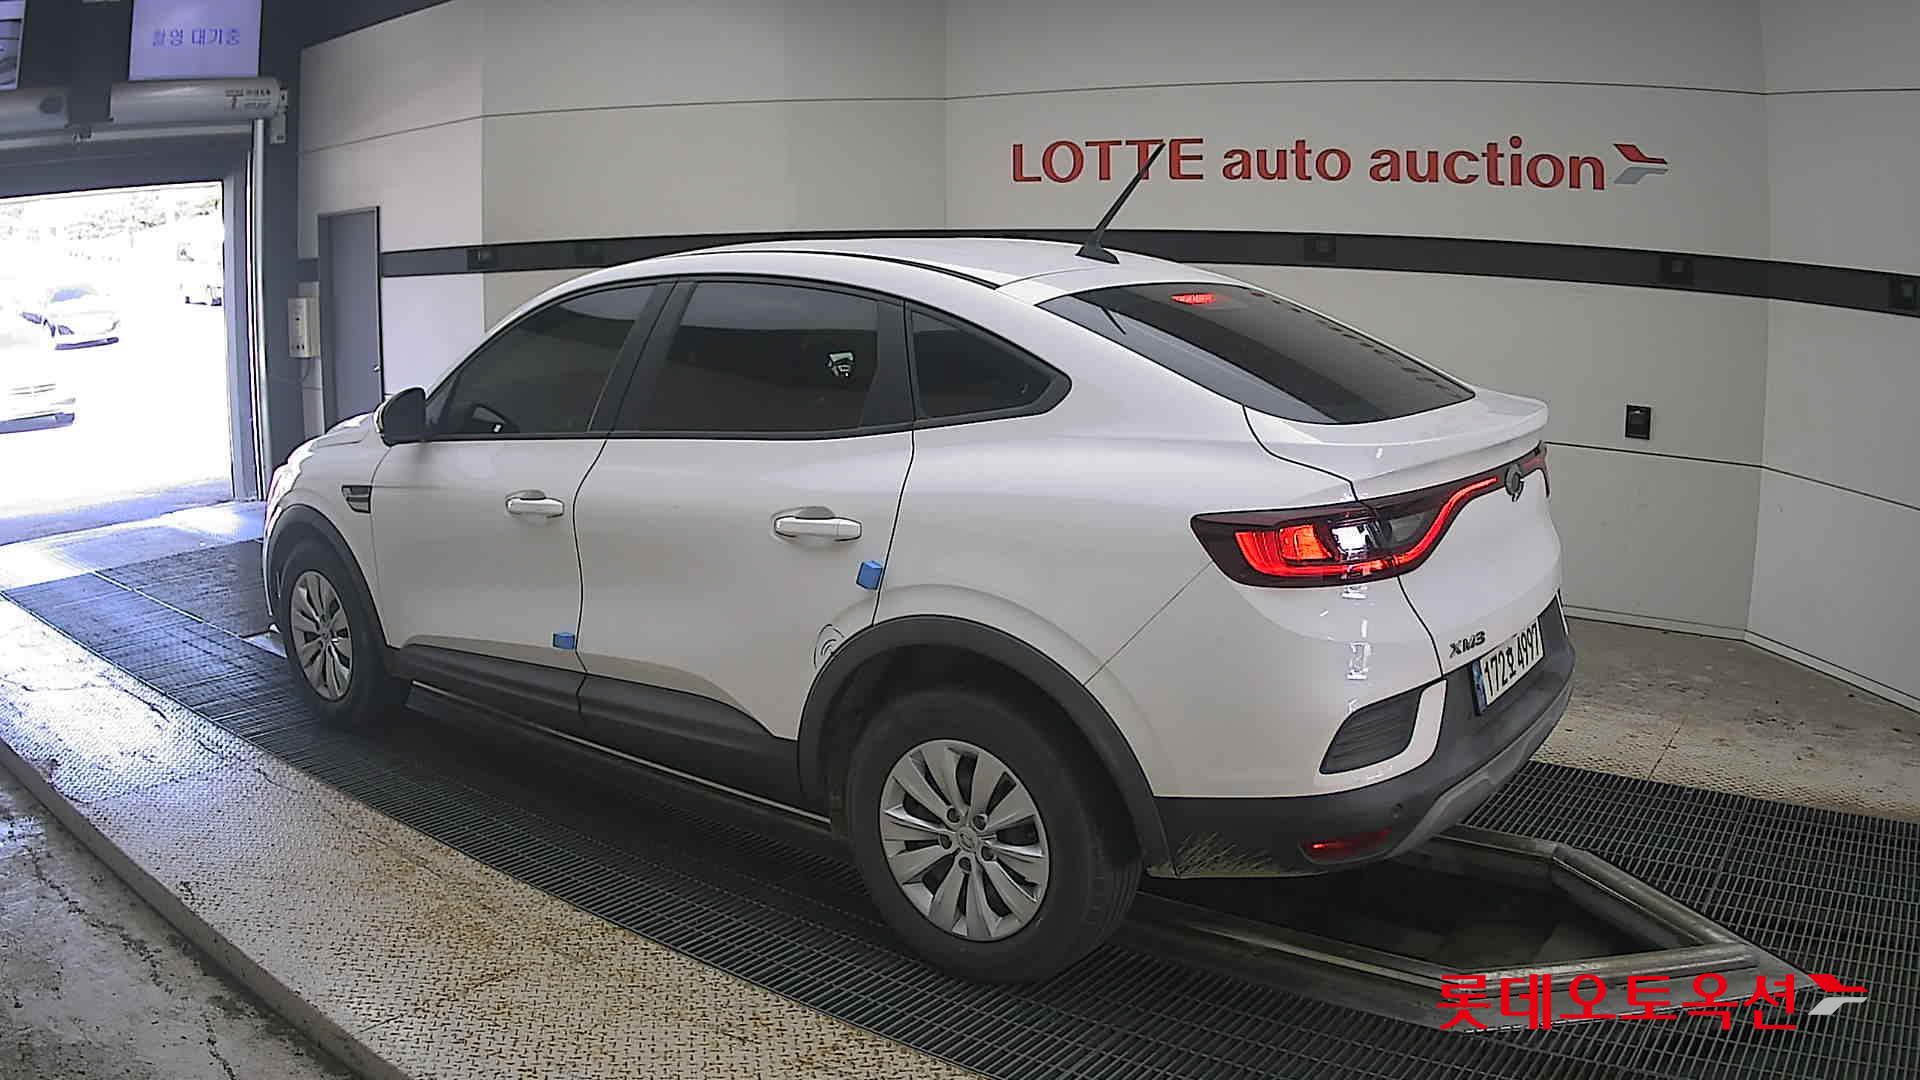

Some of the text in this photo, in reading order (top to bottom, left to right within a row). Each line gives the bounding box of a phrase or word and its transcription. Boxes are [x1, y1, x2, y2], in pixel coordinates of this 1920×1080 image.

[1011, 135, 1606, 191] LOTTE auto auction
[1449, 630, 1486, 659] XM3
[1484, 621, 1540, 697] 172호 4997
